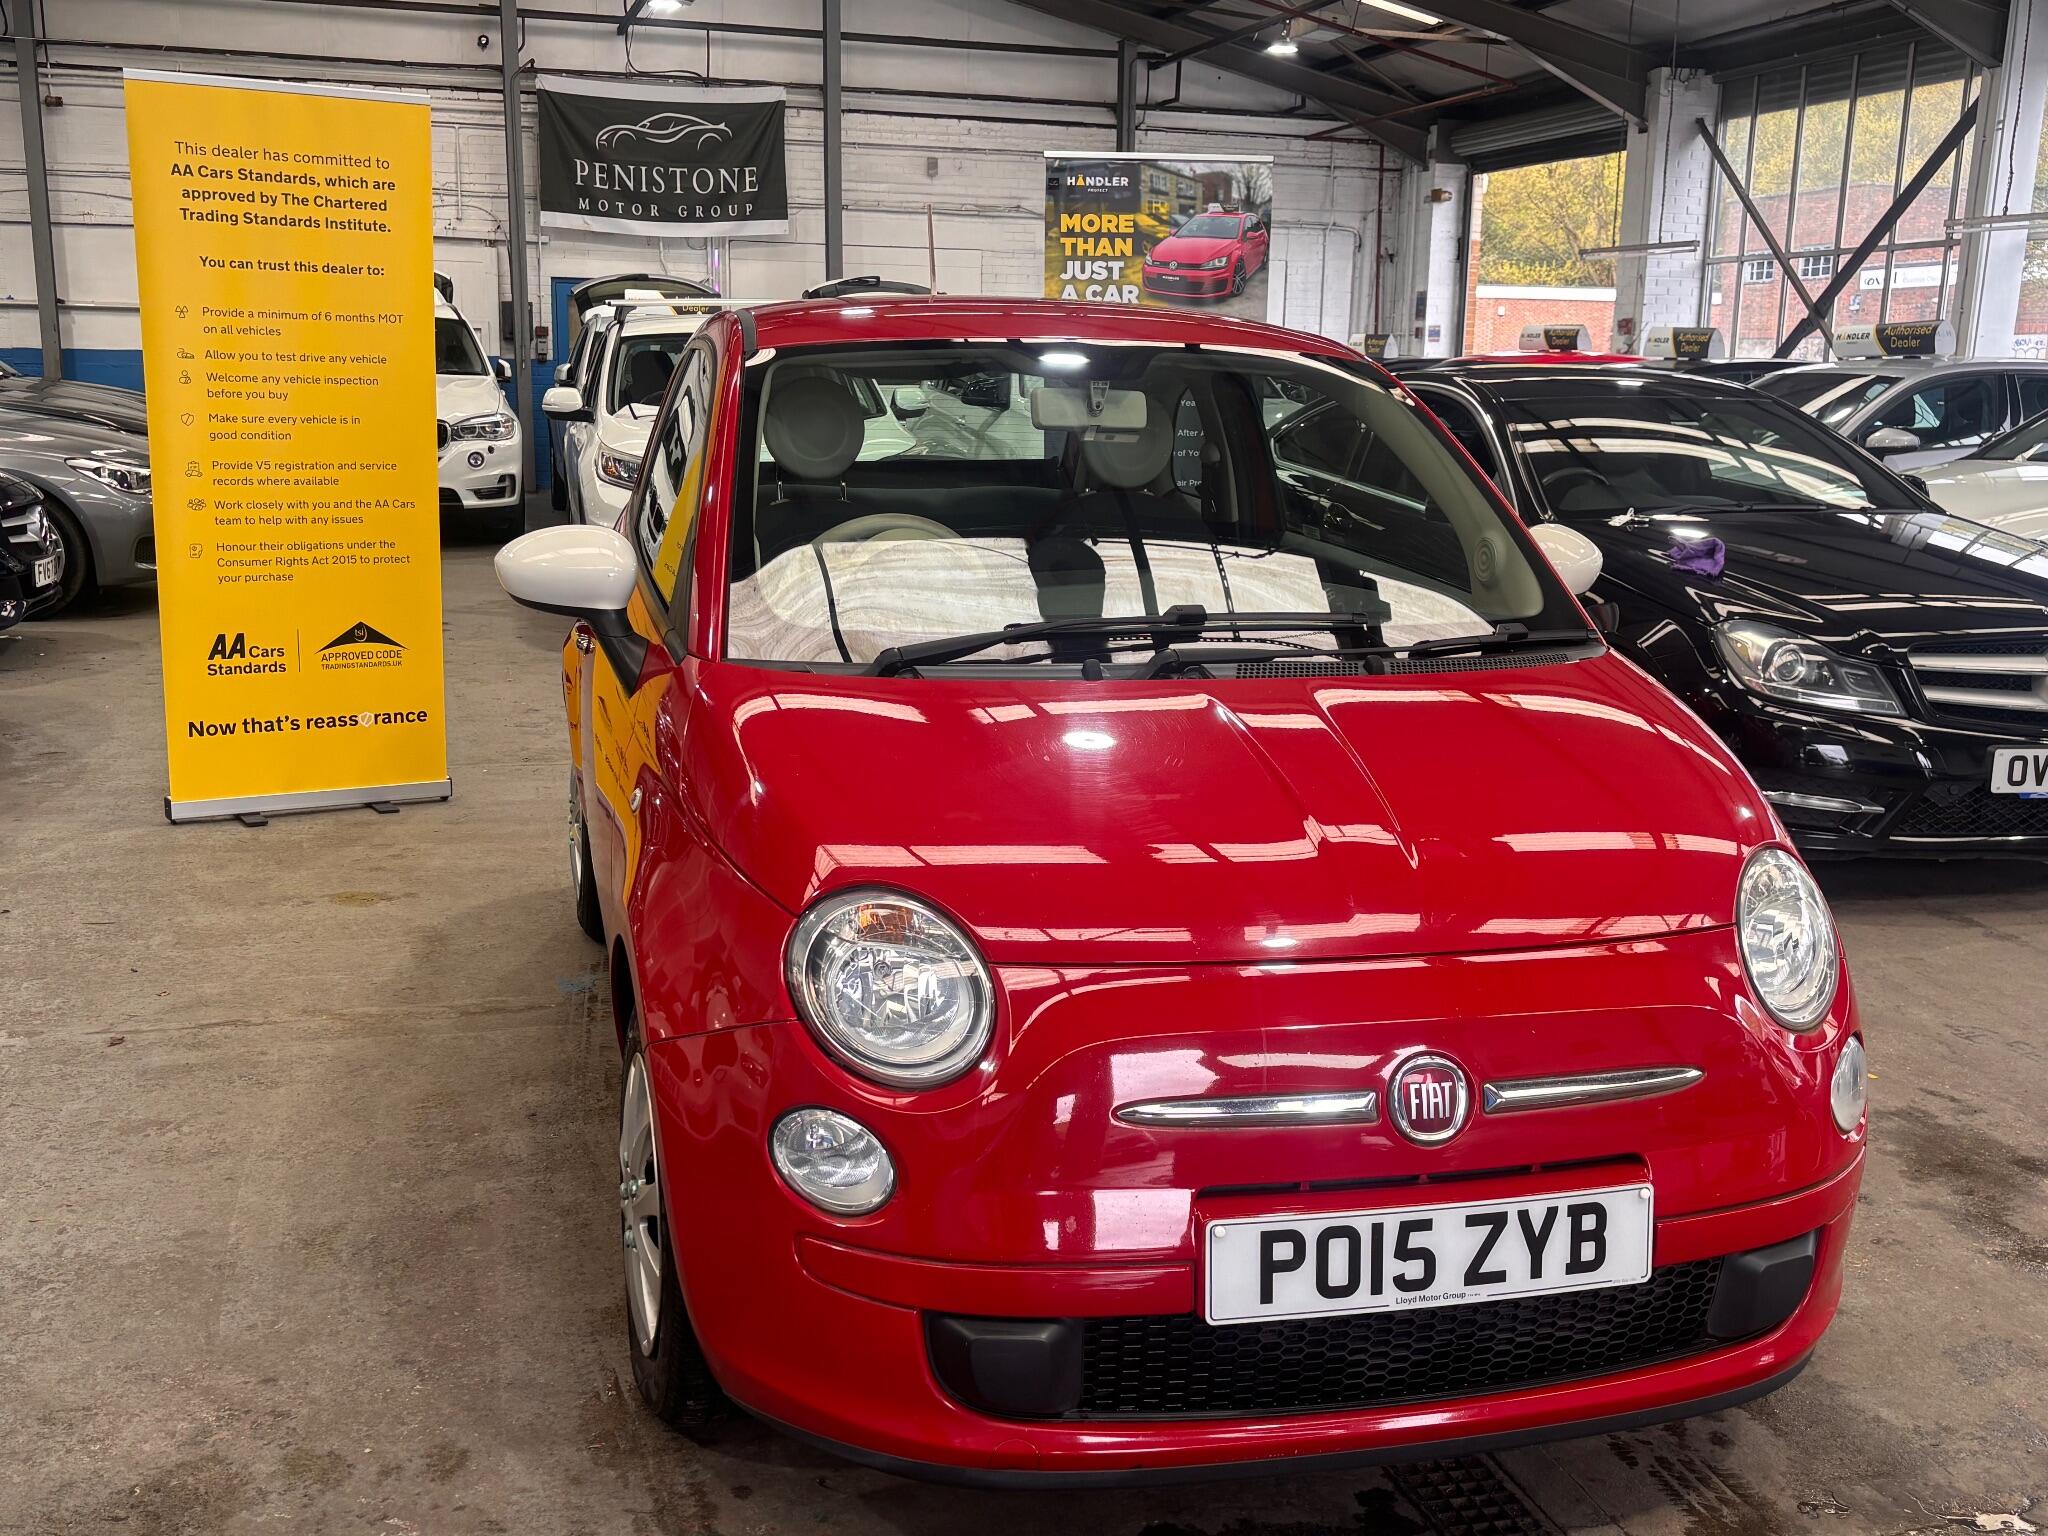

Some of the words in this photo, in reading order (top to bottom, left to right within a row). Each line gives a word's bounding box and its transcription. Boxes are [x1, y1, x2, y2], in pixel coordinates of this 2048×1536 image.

[174, 140, 207, 156] This
[211, 144, 259, 160] dealer
[263, 147, 289, 162] has
[293, 153, 372, 168] committed
[375, 156, 390, 170] to
[170, 163, 194, 177] AA
[197, 164, 234, 180] Cars
[237, 167, 321, 188] Standards,
[324, 175, 369, 190] which
[372, 180, 396, 191] are
[574, 158, 759, 195] PENISTONE
[181, 188, 256, 205] approved
[259, 191, 278, 208] by
[280, 192, 310, 207] The
[313, 194, 388, 212] Chartered
[578, 197, 660, 217] MOTOR
[678, 203, 754, 218] GROUP
[179, 207, 239, 226] Trading
[242, 211, 321, 229] Standards
[325, 216, 392, 233] Institute.
[1060, 214, 1134, 232] MORE
[1060, 238, 1132, 256] THAN
[199, 255, 226, 268] You
[229, 260, 254, 270] can
[256, 259, 290, 272] trust
[293, 260, 319, 273] this
[321, 262, 364, 275] dealer
[366, 264, 385, 276] to:
[1060, 260, 1124, 280] JUST
[1060, 284, 1080, 300] A
[1085, 284, 1140, 304] CAR
[202, 306, 245, 318] Provide
[247, 310, 255, 319] a
[257, 309, 309, 321] minimum
[311, 311, 322, 321] of
[325, 311, 332, 322] 6
[335, 312, 376, 323] months
[378, 313, 404, 324] MOT
[682, 304, 710, 312] Dealer
[203, 326, 218, 334] on
[220, 324, 234, 335] all
[235, 325, 282, 337] vehicles
[1884, 325, 1934, 336] Authorised
[1890, 337, 1920, 348] Dealer
[204, 349, 236, 360] Allow
[238, 352, 259, 363] you
[261, 351, 273, 361] to
[275, 351, 297, 362] test
[299, 352, 326, 363] drive
[327, 354, 348, 366] any
[349, 354, 387, 365] vehicle
[205, 372, 259, 384] Welcome
[261, 375, 281, 387] any
[283, 374, 322, 385] vehicle
[324, 375, 379, 387] inspection
[206, 388, 243, 399] before
[245, 391, 265, 402] you
[268, 389, 289, 402] buy
[208, 413, 239, 424] Make
[241, 415, 265, 424] sure
[267, 416, 298, 426] every
[299, 414, 337, 425] vehicle
[339, 415, 349, 425] is
[351, 415, 361, 425] in
[209, 430, 238, 442] good
[240, 430, 292, 441] condition
[1188, 449, 1200, 457] Yo
[212, 460, 254, 470] Provide
[255, 460, 272, 470] V5
[274, 460, 335, 473] registration
[337, 460, 357, 471] and
[359, 462, 398, 470] service
[212, 476, 254, 486] records
[256, 476, 291, 486] where
[293, 475, 340, 486] available
[213, 500, 244, 510] Work
[245, 499, 284, 512] closely
[286, 499, 310, 510] with
[311, 501, 331, 512] you
[333, 499, 353, 509] and
[354, 498, 372, 509] the
[374, 498, 390, 509] AA
[391, 498, 416, 509] Cars
[214, 516, 242, 526] team
[244, 515, 256, 525] to
[258, 515, 283, 527] help
[284, 515, 308, 525] with
[310, 516, 329, 527] any
[331, 514, 364, 524] issues
[216, 542, 257, 552] Honour
[259, 541, 284, 551] their
[286, 540, 344, 552] obligations
[346, 540, 377, 550] under
[378, 539, 396, 549] the
[216, 557, 273, 568] Consumer
[275, 556, 310, 568] Rights
[311, 555, 330, 566] Act
[331, 554, 358, 565] 2015
[359, 554, 371, 564] to
[373, 553, 411, 568] protect
[217, 575, 242, 586] your
[244, 572, 294, 584] purchase
[207, 632, 246, 661] AA
[248, 645, 285, 659] Cars
[321, 650, 374, 662] APPROVED
[376, 649, 402, 659] CODE
[207, 660, 287, 676] Standards
[321, 660, 403, 670] TRADINGSTANDARDS.UK
[188, 720, 237, 738] Now
[241, 714, 300, 734] that's
[306, 710, 428, 730] reassrance
[1409, 1082, 1452, 1120] FIAT
[1259, 1217, 1436, 1304] PO15
[1464, 1202, 1609, 1287] ZYB
[1395, 1295, 1417, 1305] Lloyd
[1418, 1293, 1442, 1302] Motor
[1442, 1291, 1466, 1300] Group
